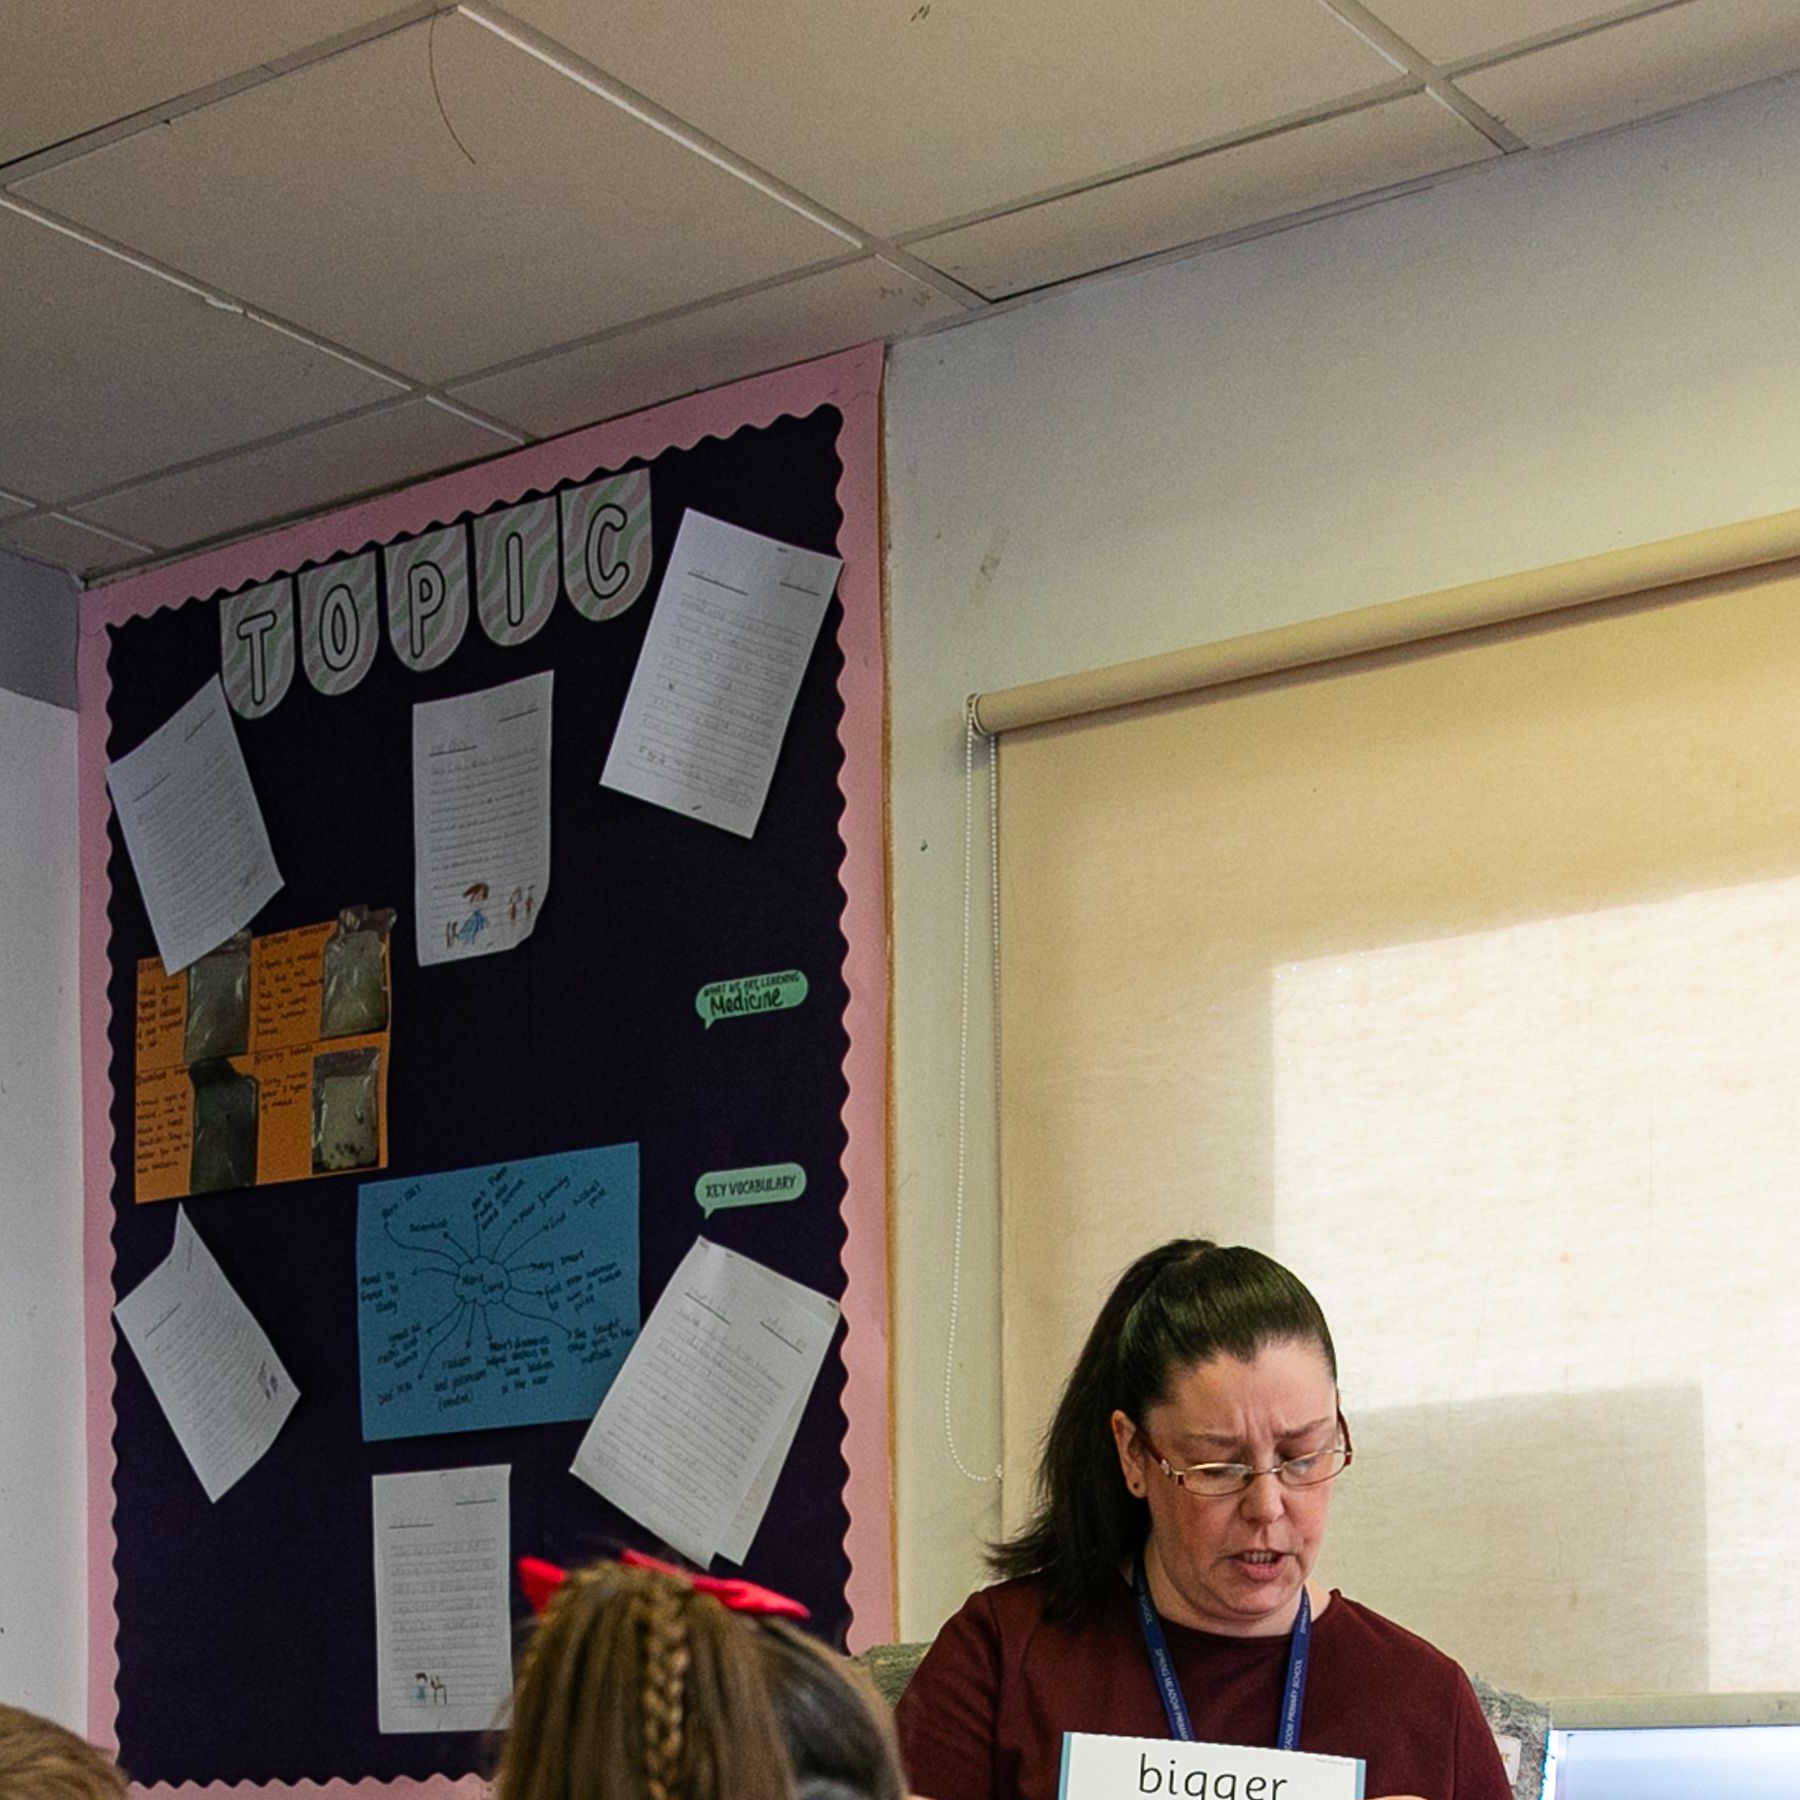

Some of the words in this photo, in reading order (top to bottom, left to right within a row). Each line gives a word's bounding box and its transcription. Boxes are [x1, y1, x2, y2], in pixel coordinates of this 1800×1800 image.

[236, 503, 630, 705] TOPIC
[710, 987, 783, 1016] Medicine
[706, 1183, 727, 1198] KEY
[729, 1175, 796, 1195] VOCABULARY
